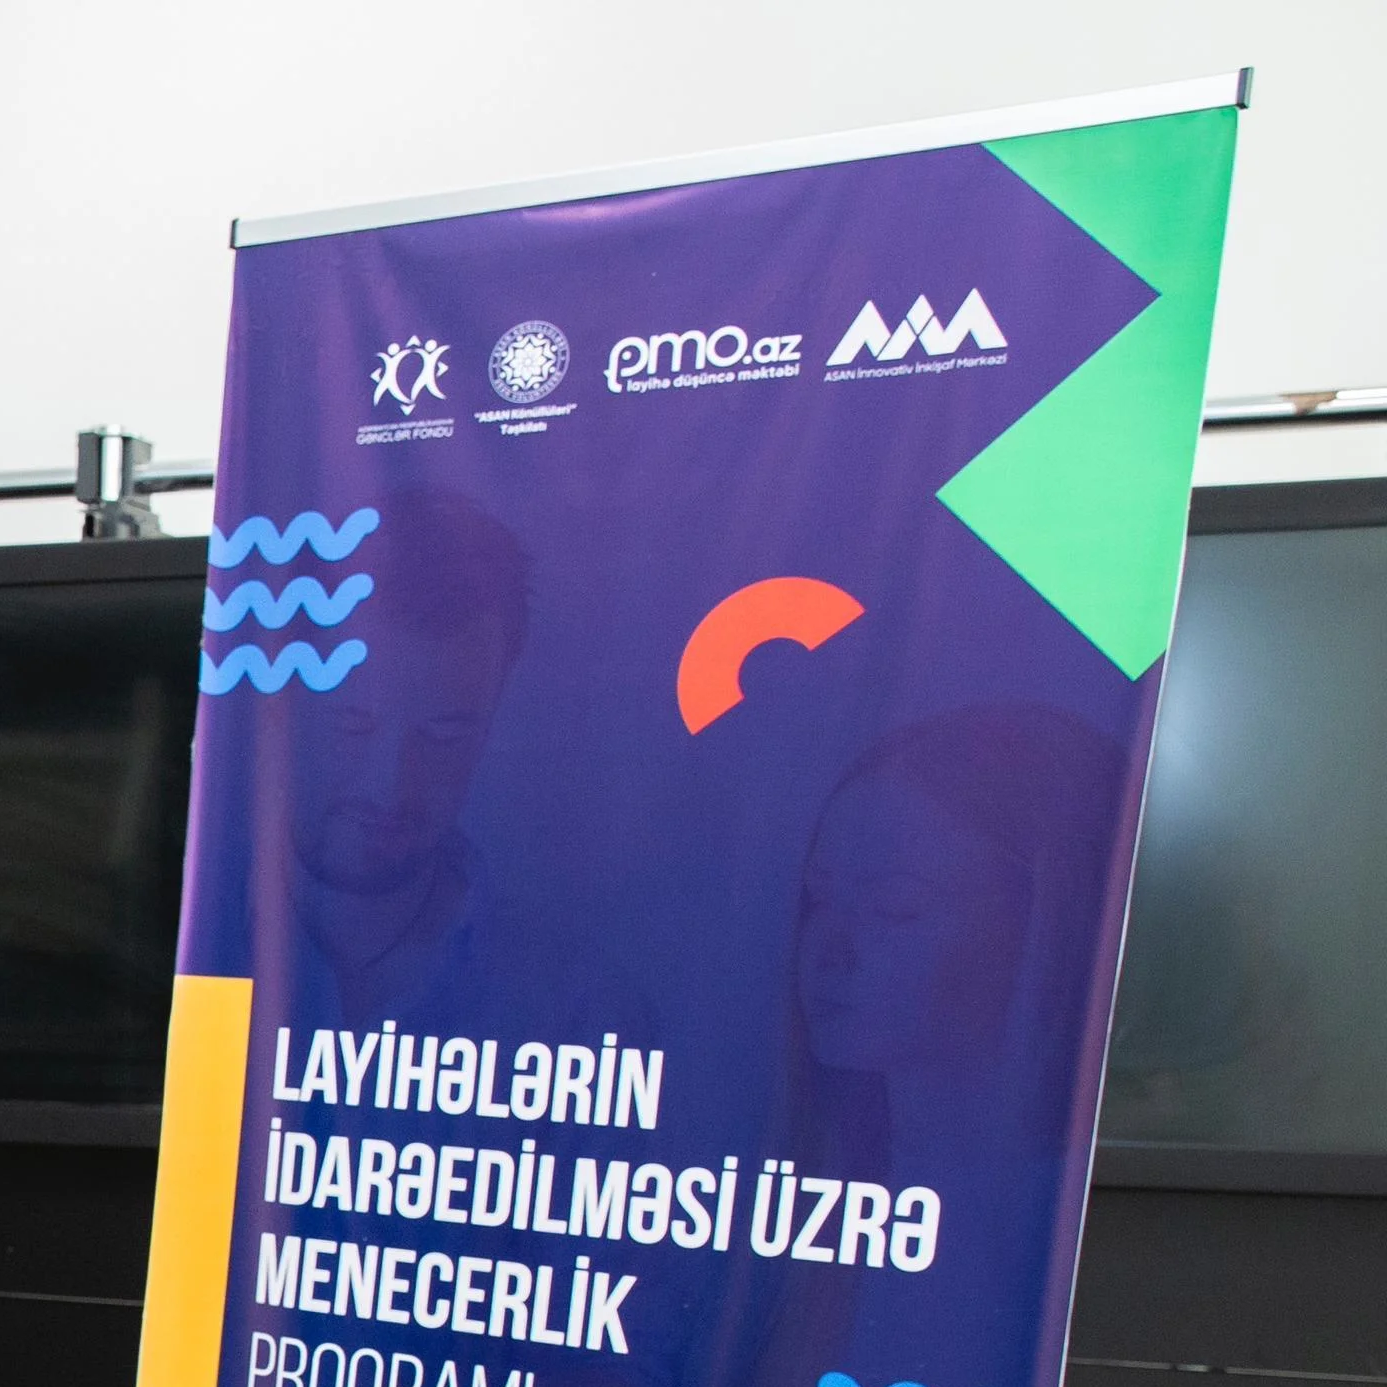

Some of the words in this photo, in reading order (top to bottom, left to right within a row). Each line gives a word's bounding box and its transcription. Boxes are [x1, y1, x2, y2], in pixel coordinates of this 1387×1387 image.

[626, 376, 672, 393] layihə
[673, 370, 736, 389] düşüncə
[737, 363, 801, 382] məktəbi
[824, 369, 856, 382] ASAN
[956, 353, 1008, 369] Mərkəzi
[412, 426, 455, 440] FONDU
[271, 1020, 665, 1131] LAYİHƏLƏRİN
[263, 1117, 739, 1252] İDARƏEDİLMƏSİ
[749, 1159, 942, 1273] ÜZRƏ
[255, 1232, 638, 1355] MENECERLİK
